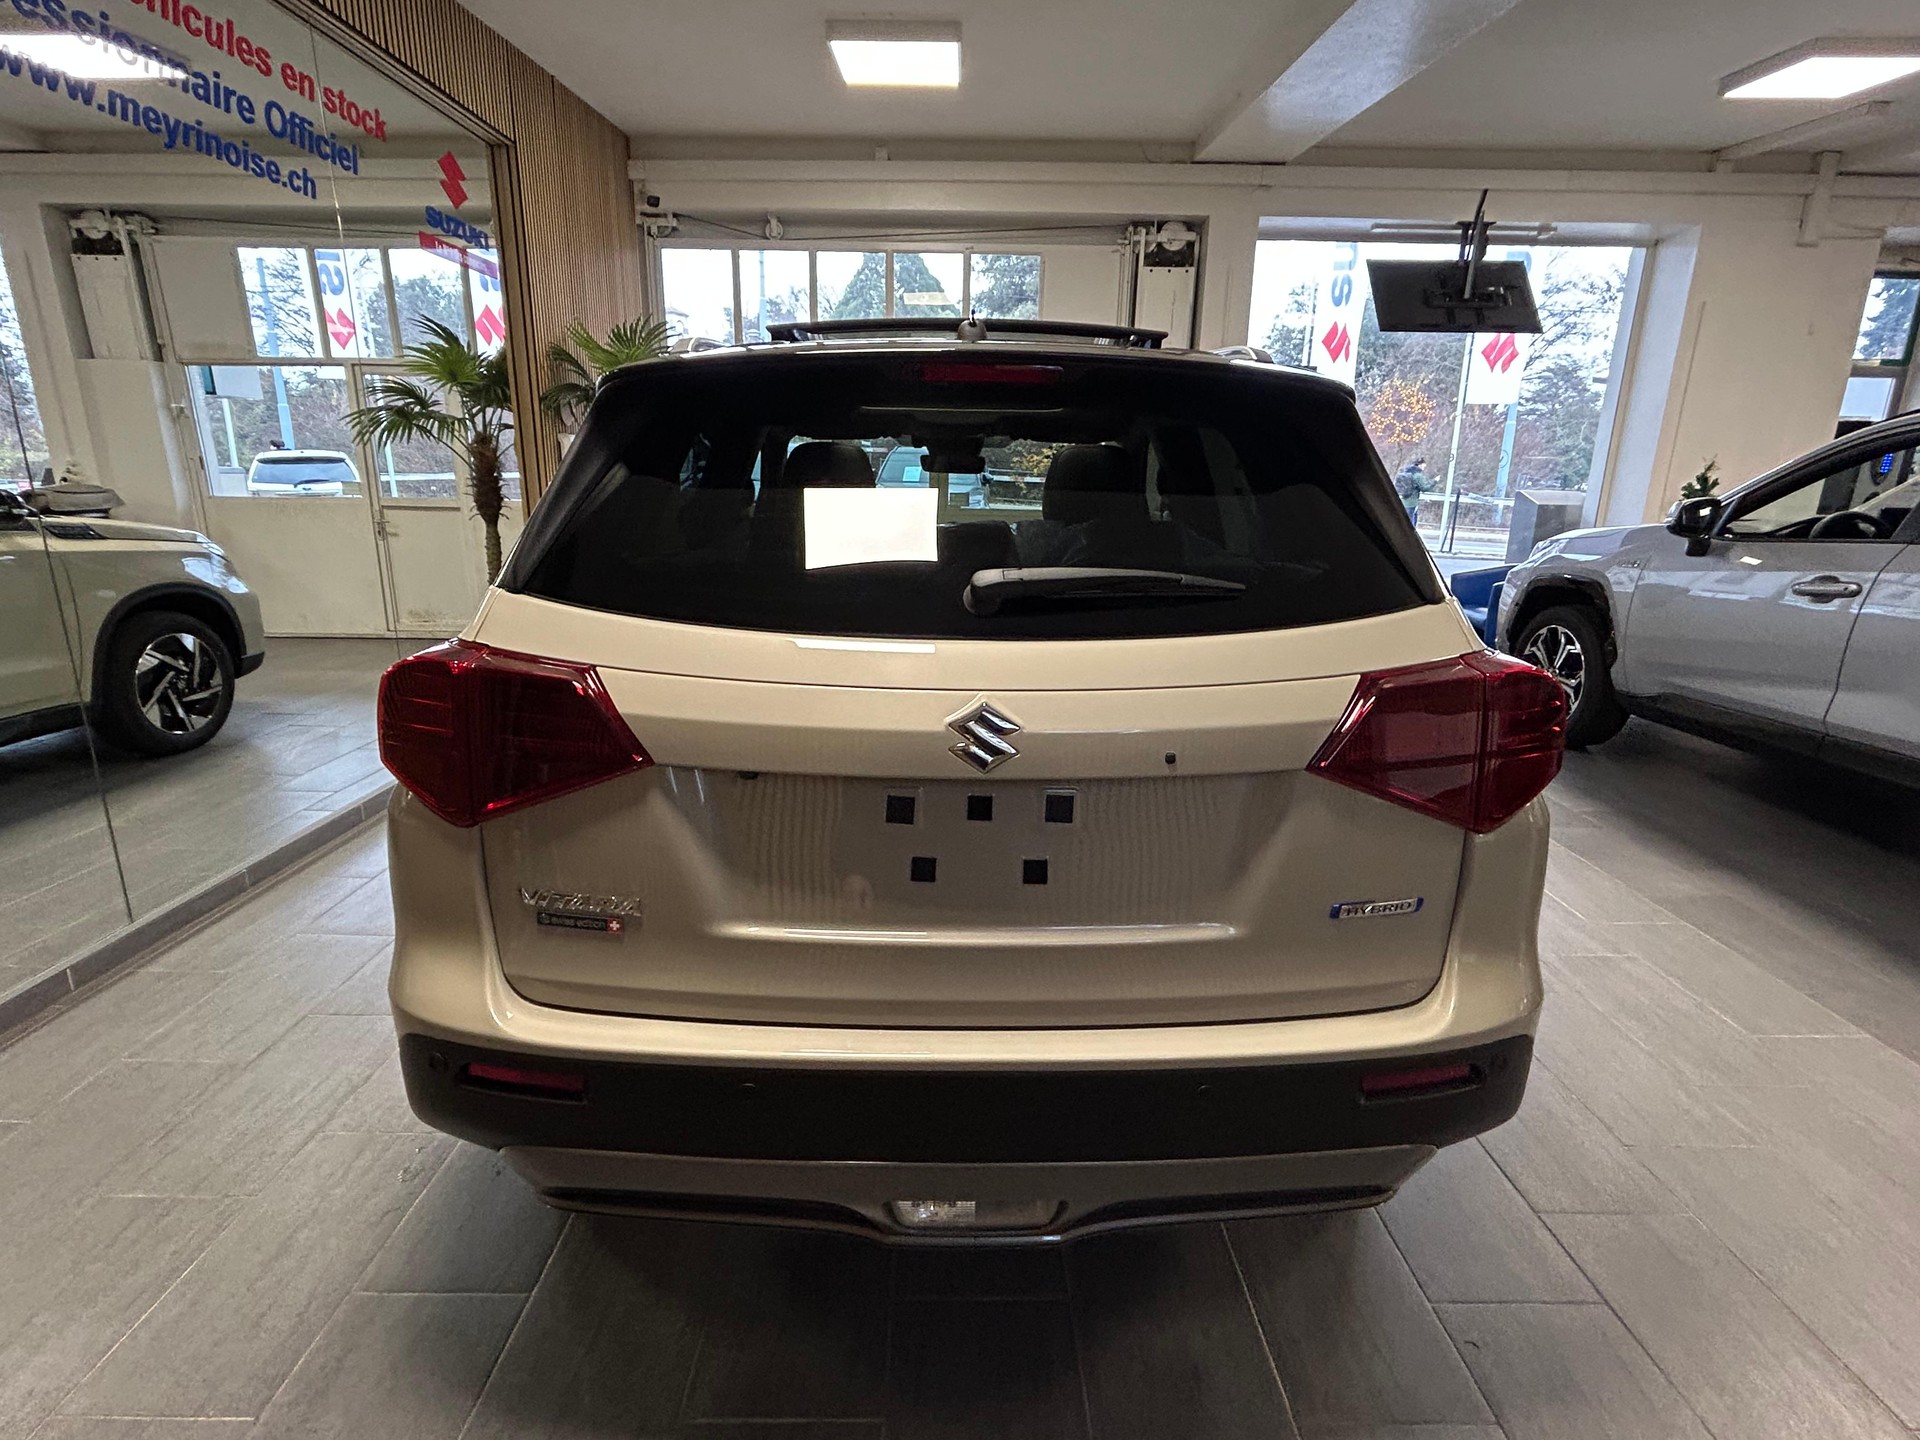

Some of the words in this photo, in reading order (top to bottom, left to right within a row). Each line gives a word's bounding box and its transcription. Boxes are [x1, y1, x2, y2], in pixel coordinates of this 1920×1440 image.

[280, 62, 315, 102] en
[322, 86, 387, 142] stock
[264, 100, 359, 175] Officiel
[425, 205, 490, 252] SUZUKI
[1345, 901, 1412, 917] HYBRID
